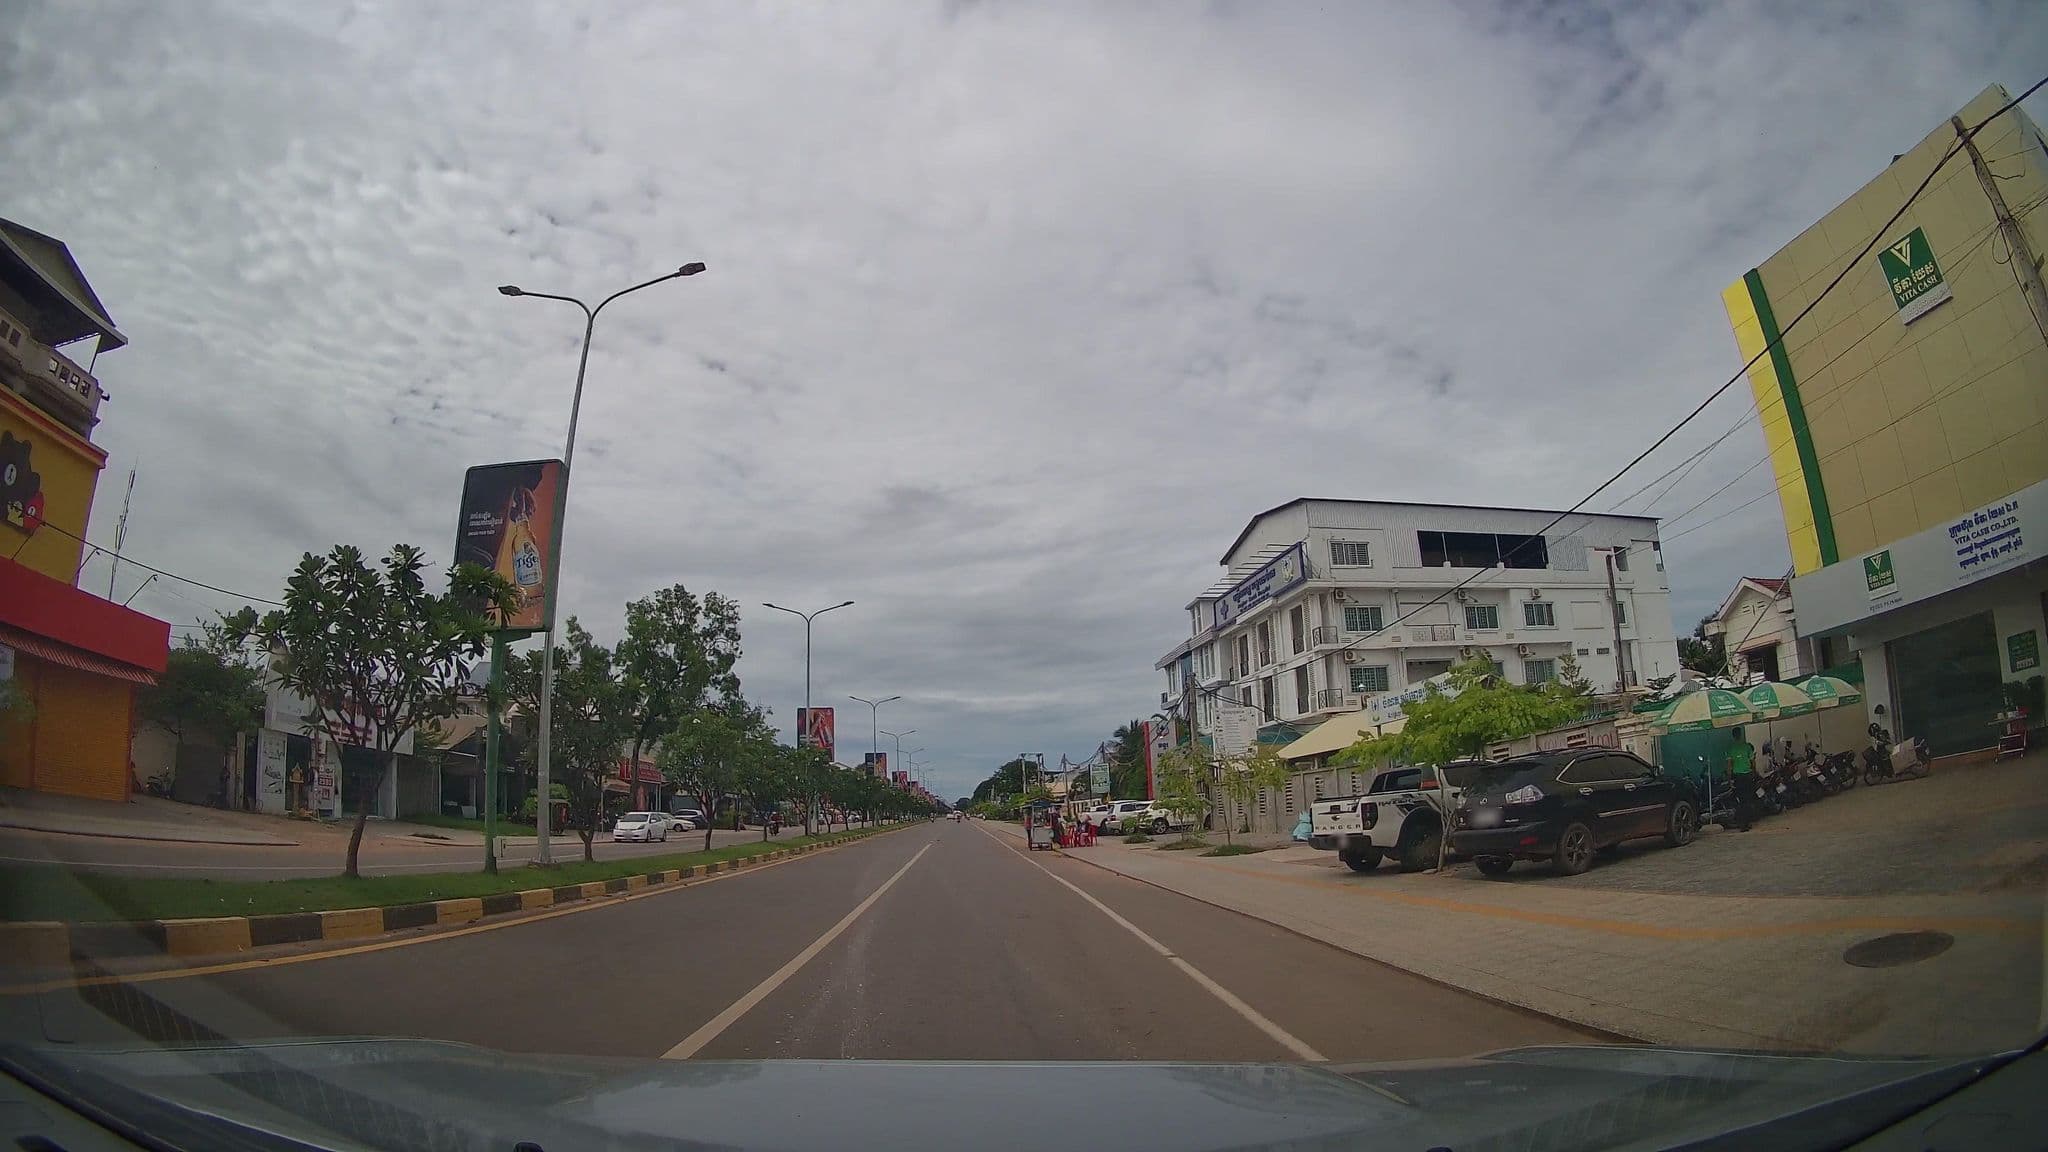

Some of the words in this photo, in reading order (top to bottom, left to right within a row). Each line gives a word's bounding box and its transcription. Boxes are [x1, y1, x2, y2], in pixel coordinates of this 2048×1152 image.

[1899, 289, 1918, 302] VITA
[1917, 274, 1938, 292] CASH
[1955, 536, 1970, 544] VITA
[1971, 527, 1990, 538] CASH
